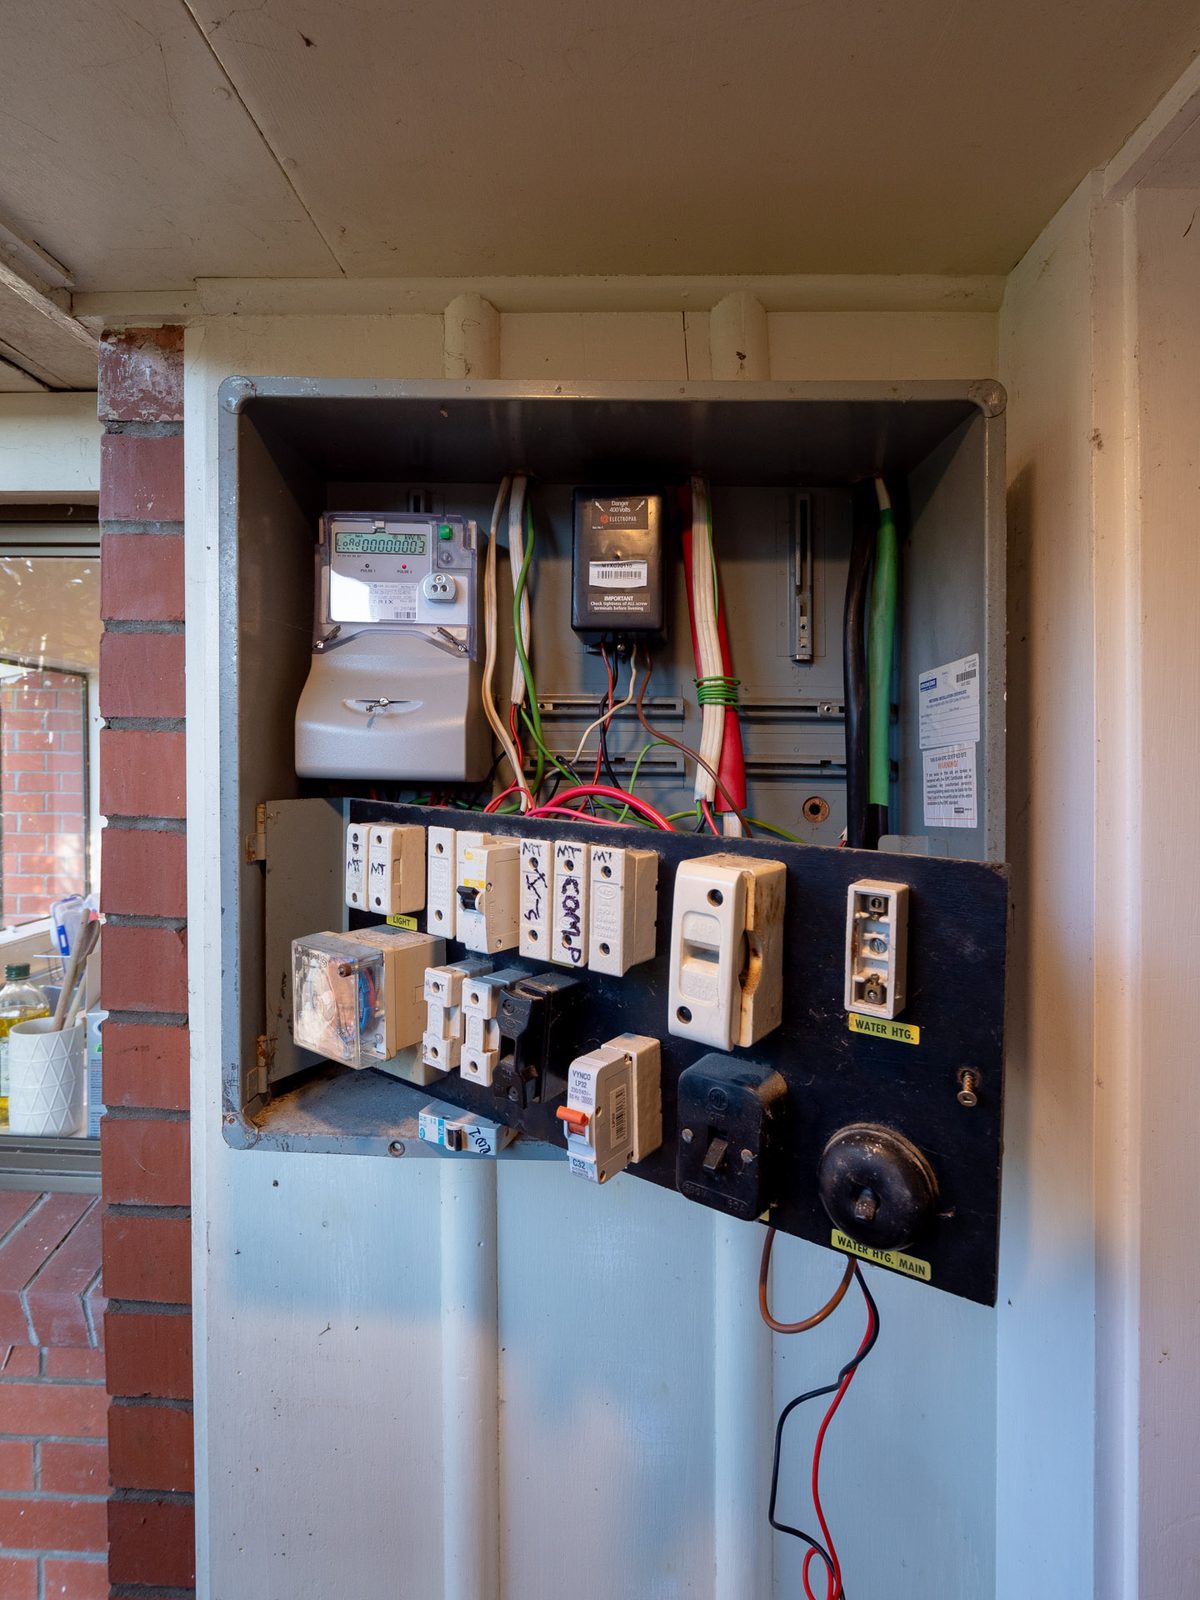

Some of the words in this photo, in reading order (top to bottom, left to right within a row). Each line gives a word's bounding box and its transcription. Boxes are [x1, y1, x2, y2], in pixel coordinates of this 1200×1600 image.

[392, 915, 411, 926] LIGHT
[855, 1018, 887, 1035] WATER
[891, 1026, 914, 1040] HTG.
[572, 1158, 586, 1170] C32
[837, 1235, 868, 1255] WATER
[872, 1249, 895, 1265] HTG.
[899, 1258, 926, 1276] MAIN
